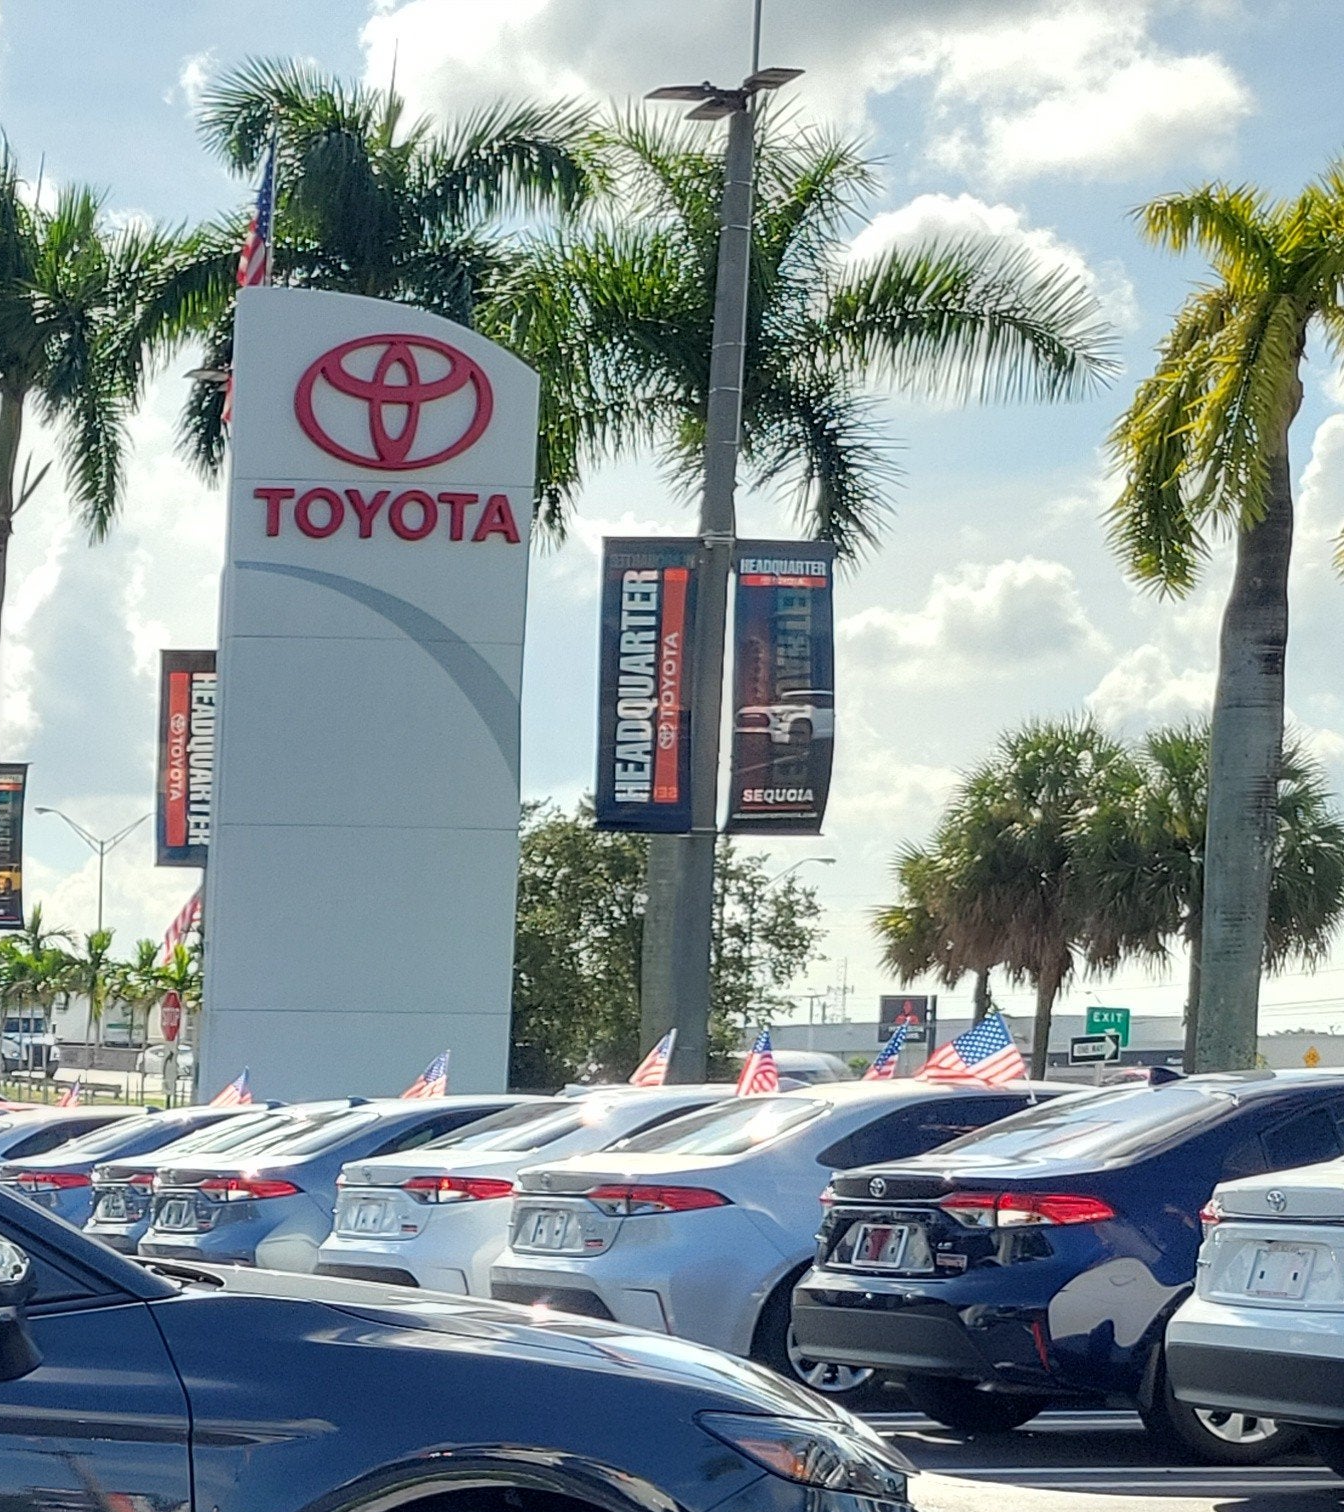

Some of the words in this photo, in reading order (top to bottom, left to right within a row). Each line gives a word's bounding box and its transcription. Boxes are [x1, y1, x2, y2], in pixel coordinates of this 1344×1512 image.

[254, 488, 520, 543] TOYOTA
[740, 559, 826, 576] HEADQUARTER
[614, 569, 660, 803] HEADQUARTER
[660, 632, 680, 722] TOYOTA
[170, 735, 184, 801] TOYOTA
[187, 672, 217, 845] HEADQUARTER
[742, 789, 813, 803] SEQUOIA
[162, 1007, 180, 1026] STOP
[1093, 1012, 1122, 1022] EXIT
